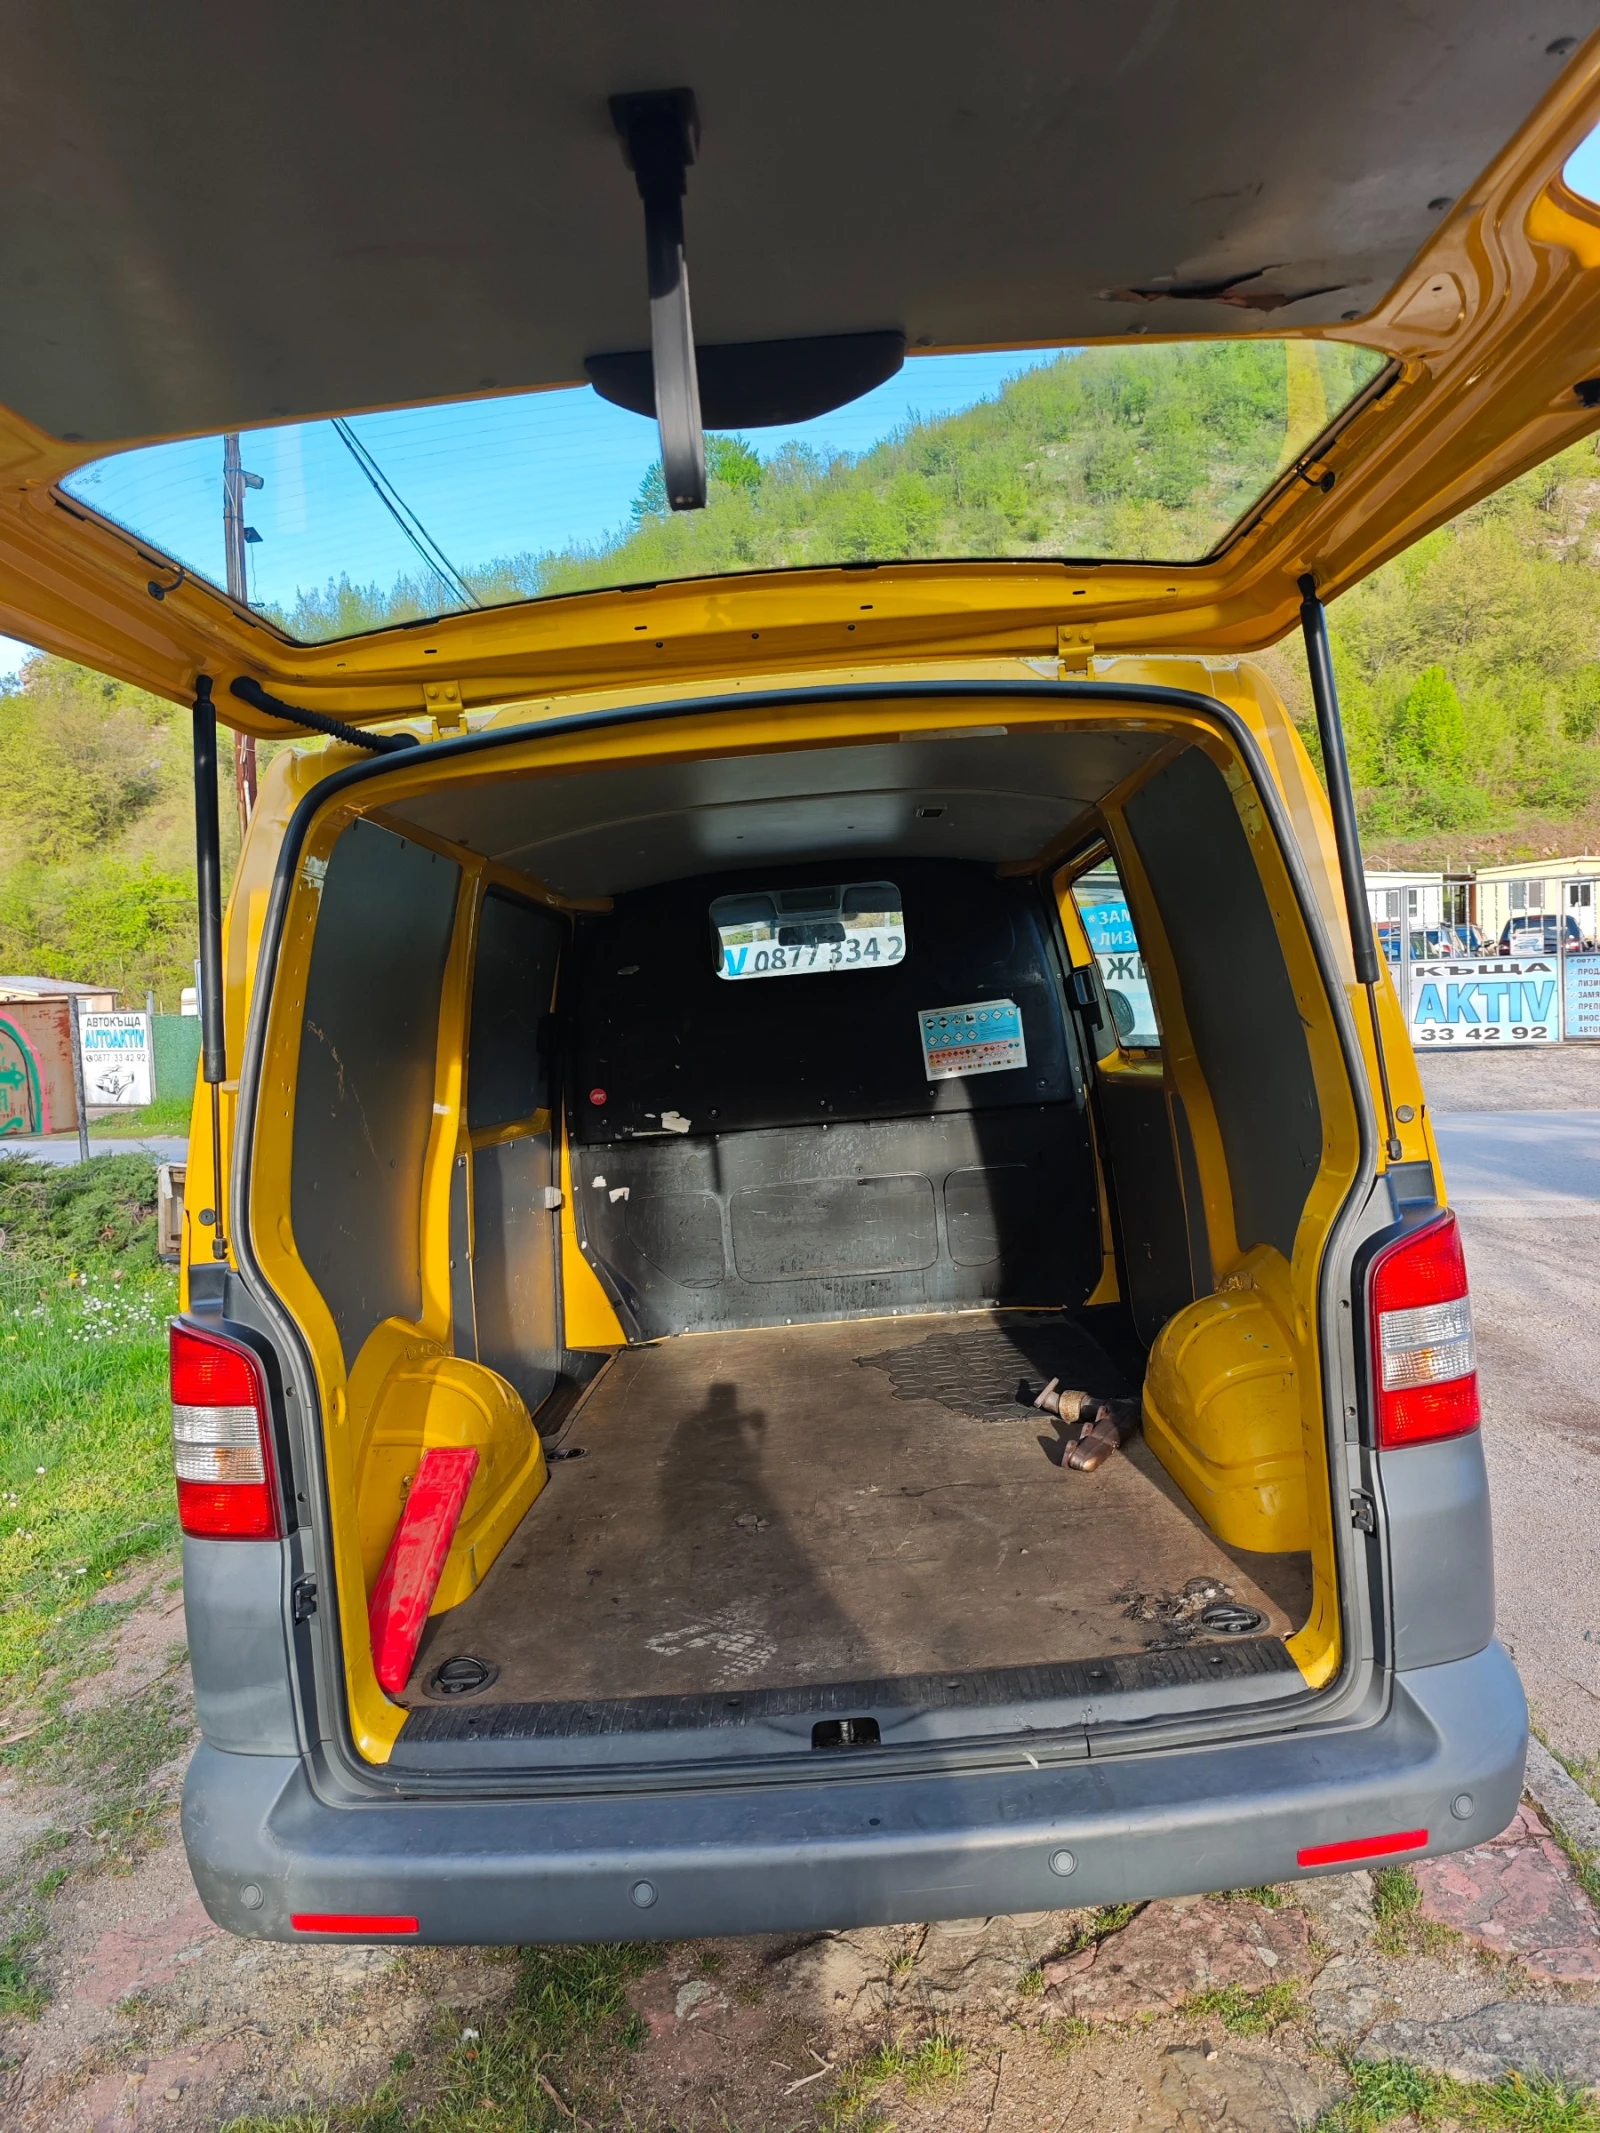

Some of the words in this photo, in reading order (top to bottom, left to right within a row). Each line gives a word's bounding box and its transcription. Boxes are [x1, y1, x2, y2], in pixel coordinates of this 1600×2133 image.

[1416, 962, 1552, 977] КЪЩА
[1578, 967, 1600, 975] ПРОД
[1414, 980, 1555, 1024] AKTIV
[1578, 991, 1600, 999] ЗАМЯ
[87, 1016, 141, 1028] АВТОКЪЩА
[85, 1029, 144, 1048] AUTOAKTIV
[1420, 1028, 1454, 1041] 33
[1465, 1027, 1500, 1040] 42
[1511, 1026, 1548, 1039] 92
